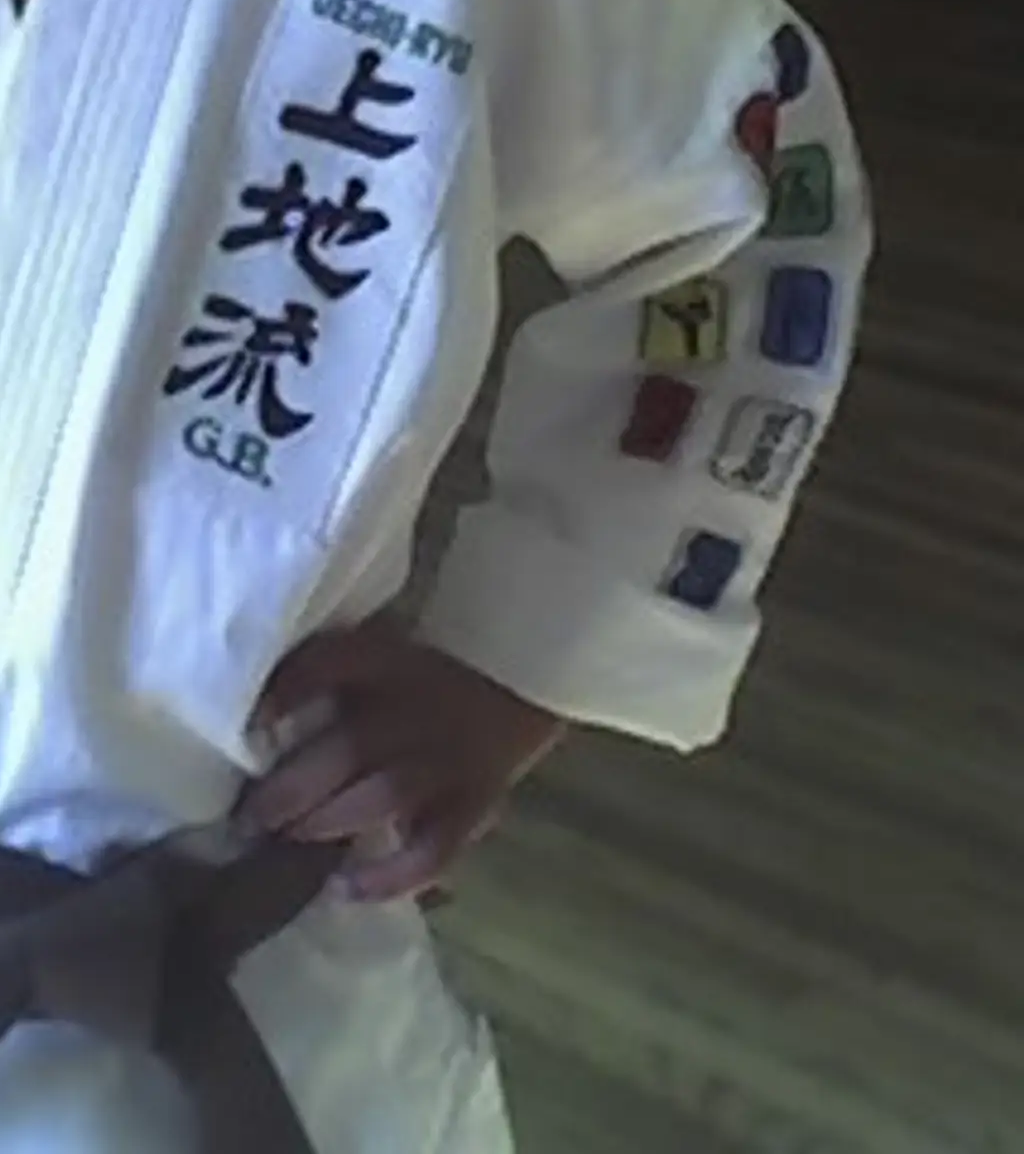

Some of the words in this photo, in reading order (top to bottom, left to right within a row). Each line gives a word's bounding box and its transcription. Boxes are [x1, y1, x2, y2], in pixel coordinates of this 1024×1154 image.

[162, 49, 417, 439] 上地流
[182, 416, 273, 487] G.B.
